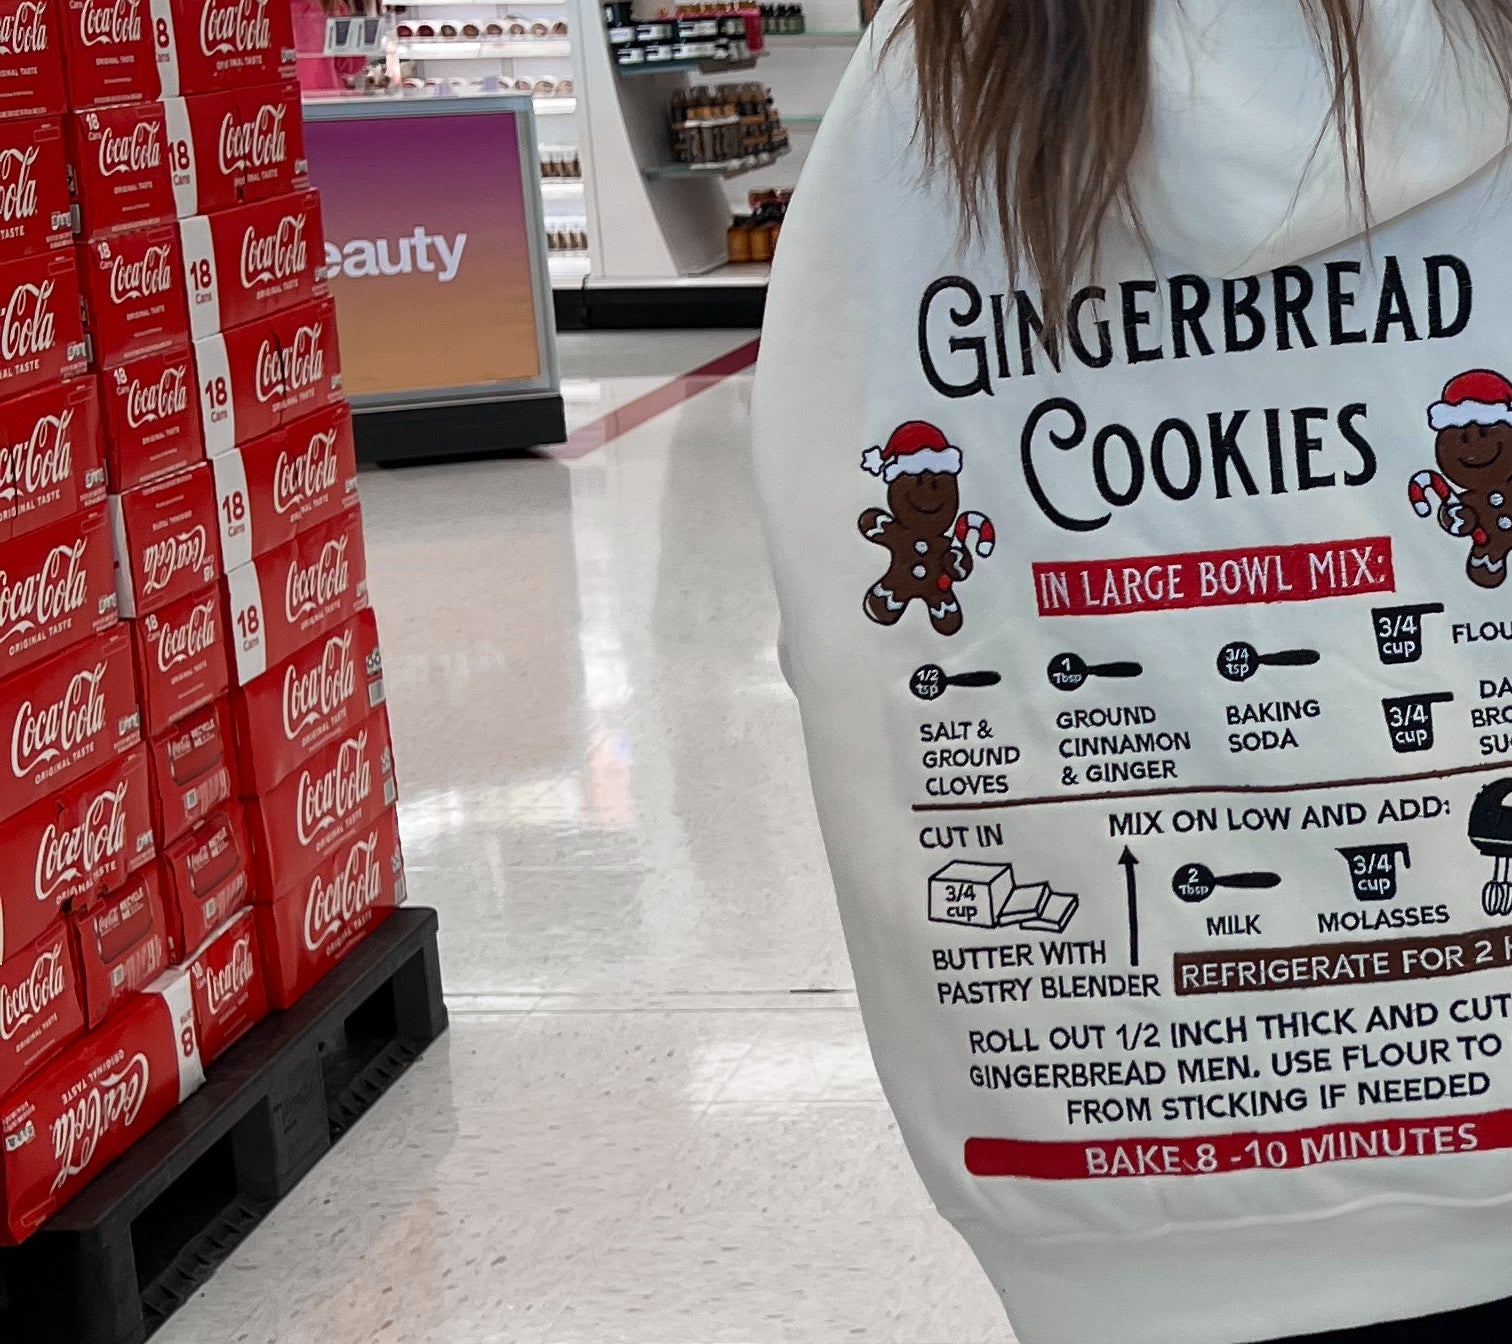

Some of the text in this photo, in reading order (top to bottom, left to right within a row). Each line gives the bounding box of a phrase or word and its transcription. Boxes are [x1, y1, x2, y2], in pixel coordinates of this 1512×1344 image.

[99, 121, 162, 177] Coca-Cola
[218, 103, 287, 176] Coca-Cola
[168, 140, 190, 172] 18
[1, 225, 25, 241] TASTE
[240, 213, 307, 290] Coca-Cola
[110, 244, 171, 304] Coca-Cola
[189, 258, 212, 291] 18
[15, 359, 40, 373] TASTE
[256, 322, 323, 403] Coca-Cola
[127, 364, 187, 429] Coca-Cola
[205, 376, 228, 409] 18
[273, 428, 338, 515] Coca-Cola
[1021, 397, 1378, 532] COOKIES
[37, 488, 61, 507] TASTE
[222, 491, 245, 524] 18
[285, 534, 350, 624] Coca-Cola
[1039, 547, 1386, 610] IN LARGE BOWL MIX:
[9, 618, 73, 657] ORIGINAL TASTE
[158, 599, 215, 673] Coca-Cola
[236, 605, 260, 638] 18
[1379, 615, 1418, 639] 3/4
[1061, 658, 1071, 671] 1
[1225, 647, 1250, 663] 3/4
[1383, 640, 1415, 657] cup
[282, 629, 355, 741] Coca-Cola
[917, 669, 939, 682] 1/2
[1053, 672, 1082, 685] Tbsp
[1226, 662, 1250, 676] tsp
[916, 682, 939, 696] tsp
[12, 662, 105, 779] Coca-Cola
[1056, 706, 1156, 729] GROUND
[1226, 700, 1321, 725] BAKING
[1390, 704, 1428, 727] 3/4
[920, 720, 993, 742] SALT &
[1059, 731, 1191, 758] CINNAMON
[1228, 732, 1299, 753] SODA
[1396, 728, 1428, 746] cup
[34, 740, 96, 785] ORIGINAL TASTE
[923, 745, 1020, 769] GROUND
[1062, 760, 1177, 785] & GINGER
[296, 727, 372, 847] Coca-Cola
[925, 775, 1009, 797] CLOVES
[1109, 796, 1451, 837] MIX ON LOW AND ADD:
[35, 779, 128, 903] Coca-Cola
[919, 824, 1003, 849] CUT IN
[1188, 868, 1198, 883] 2
[1353, 852, 1393, 875] 3/4
[304, 828, 382, 952] Coca-Cola
[945, 884, 976, 902] 3/4
[1179, 884, 1209, 896] Tbsp
[1358, 876, 1391, 894] cup
[946, 905, 978, 922] cup
[1206, 914, 1261, 937] MILK
[1318, 904, 1451, 933] MOLASSES
[933, 940, 1106, 971] BUTTER WITH
[1181, 950, 1389, 990] REFRIGERATE
[1402, 945, 1464, 973] FOR
[1475, 940, 1494, 964] 2
[207, 933, 253, 1016] Coca-Cola
[937, 973, 1161, 1005] PASTRY BLENDER
[0, 943, 65, 1041] Coca-Cola
[968, 1028, 1040, 1054] ROLL
[1049, 1025, 1106, 1051] OUT
[1116, 1022, 1160, 1052] 1/2
[1171, 1015, 1247, 1048] INCH
[1256, 1007, 1357, 1040] THICK
[1365, 1002, 1438, 1033] AND
[1450, 992, 1511, 1023] CUT
[969, 1060, 1166, 1090] GINGERBREAD
[1177, 1054, 1261, 1084] MEN.
[1271, 1048, 1332, 1078] USE
[1343, 1037, 1451, 1072] FLOUR
[1457, 1033, 1502, 1061] TO
[1067, 1071, 1491, 1125] FROM STICKING IF NEEDED
[50, 1052, 149, 1195] Coca-Cola
[1085, 1144, 1182, 1177] BAKE
[1195, 1143, 1218, 1173] 8
[1301, 1123, 1478, 1166] MINUTES
